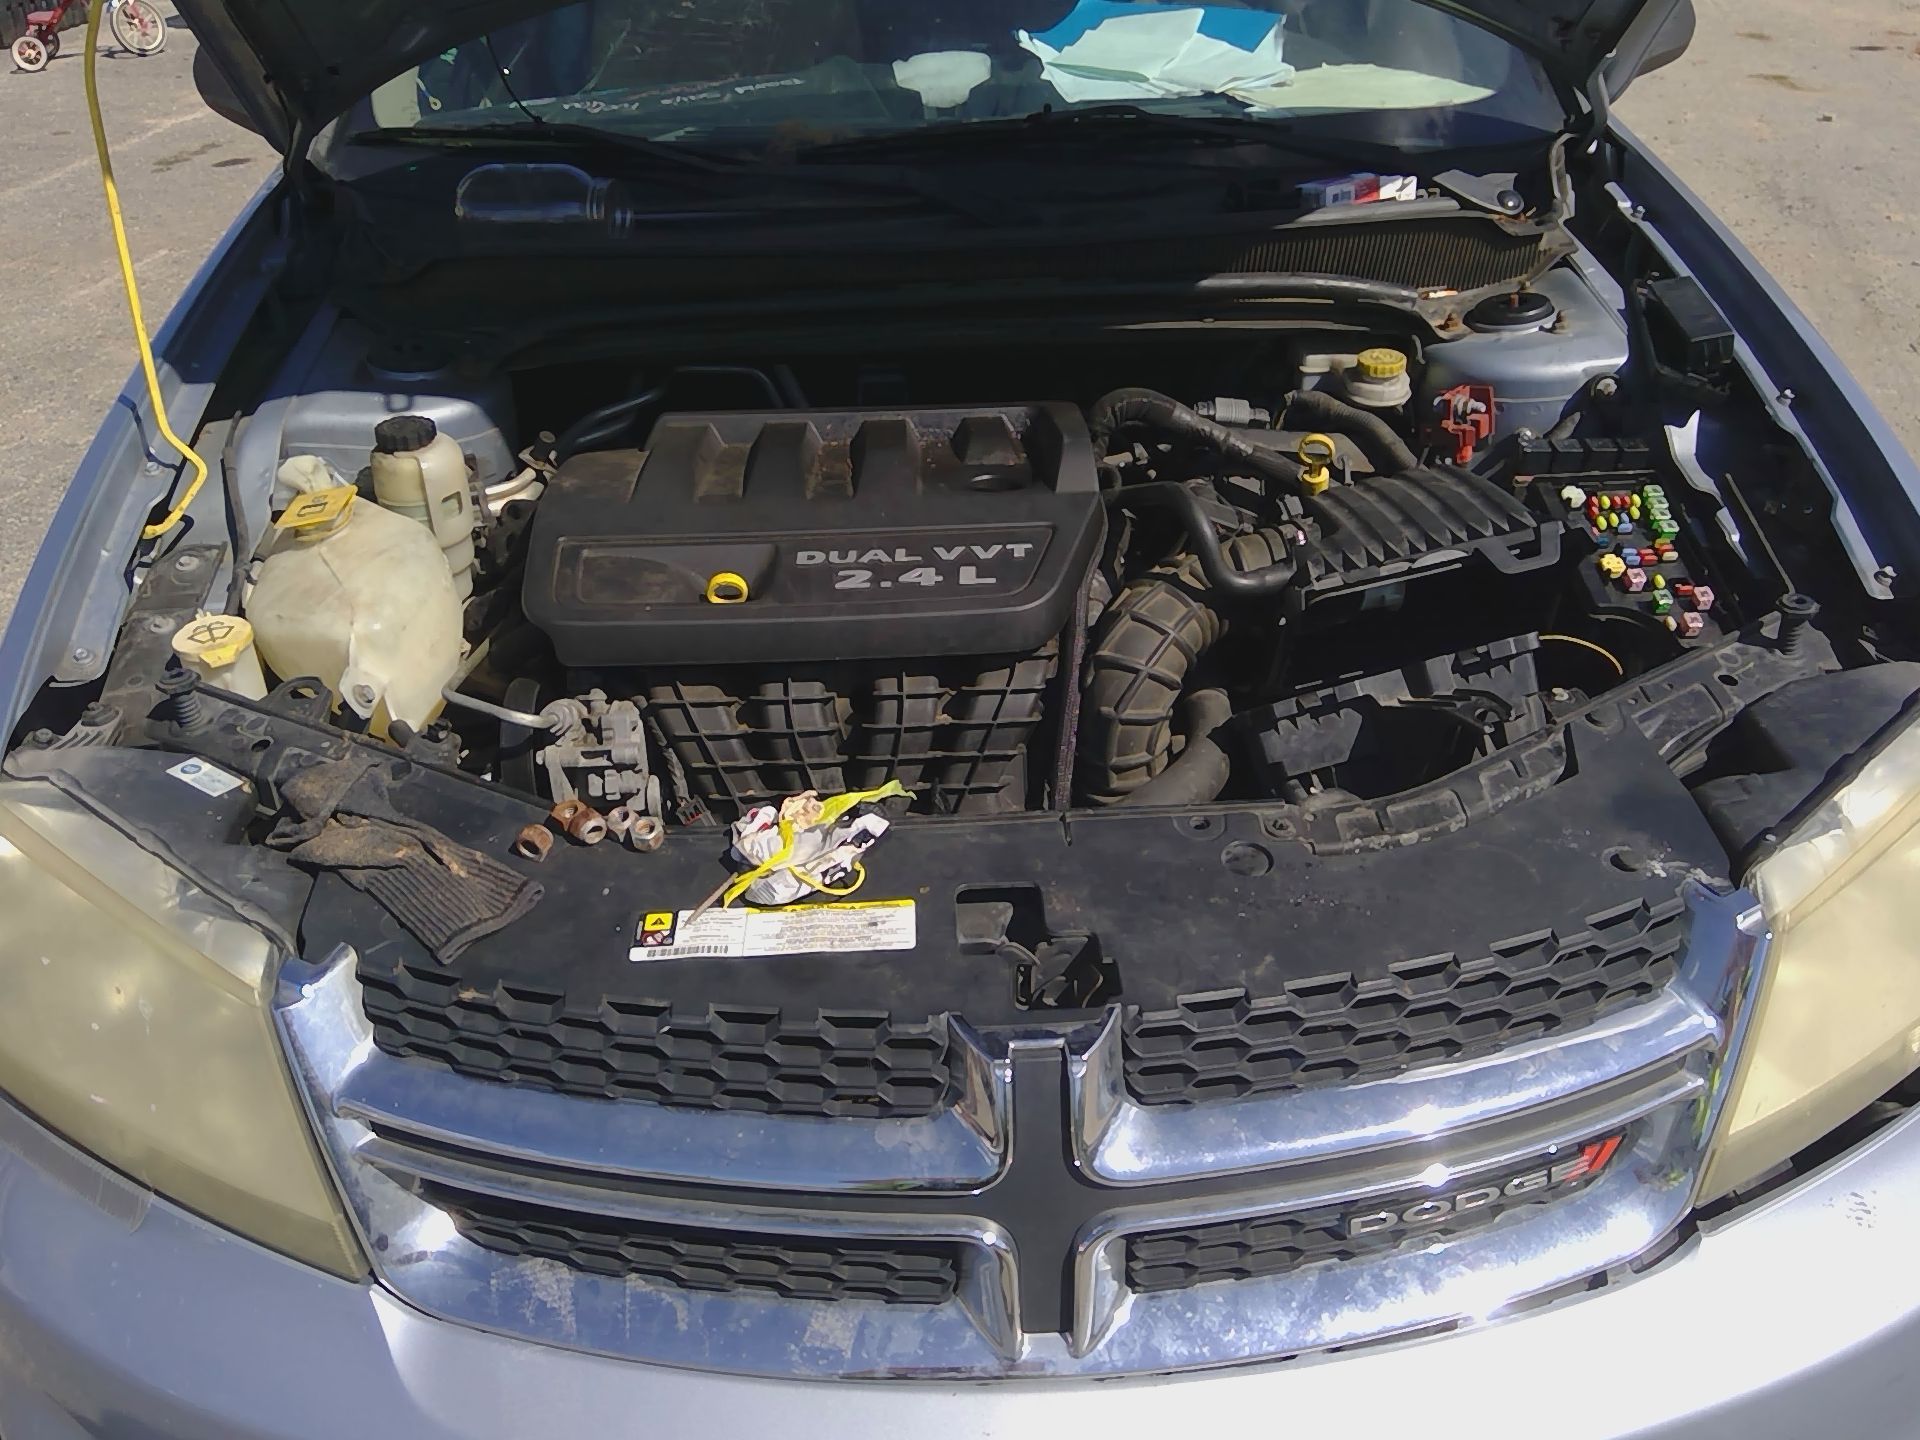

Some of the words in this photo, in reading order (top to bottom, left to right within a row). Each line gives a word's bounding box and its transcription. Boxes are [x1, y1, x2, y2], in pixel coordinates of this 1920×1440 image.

[796, 548, 922, 565] DUAL
[933, 543, 1033, 561] VVT
[1350, 1154, 1592, 1236] DODGE
